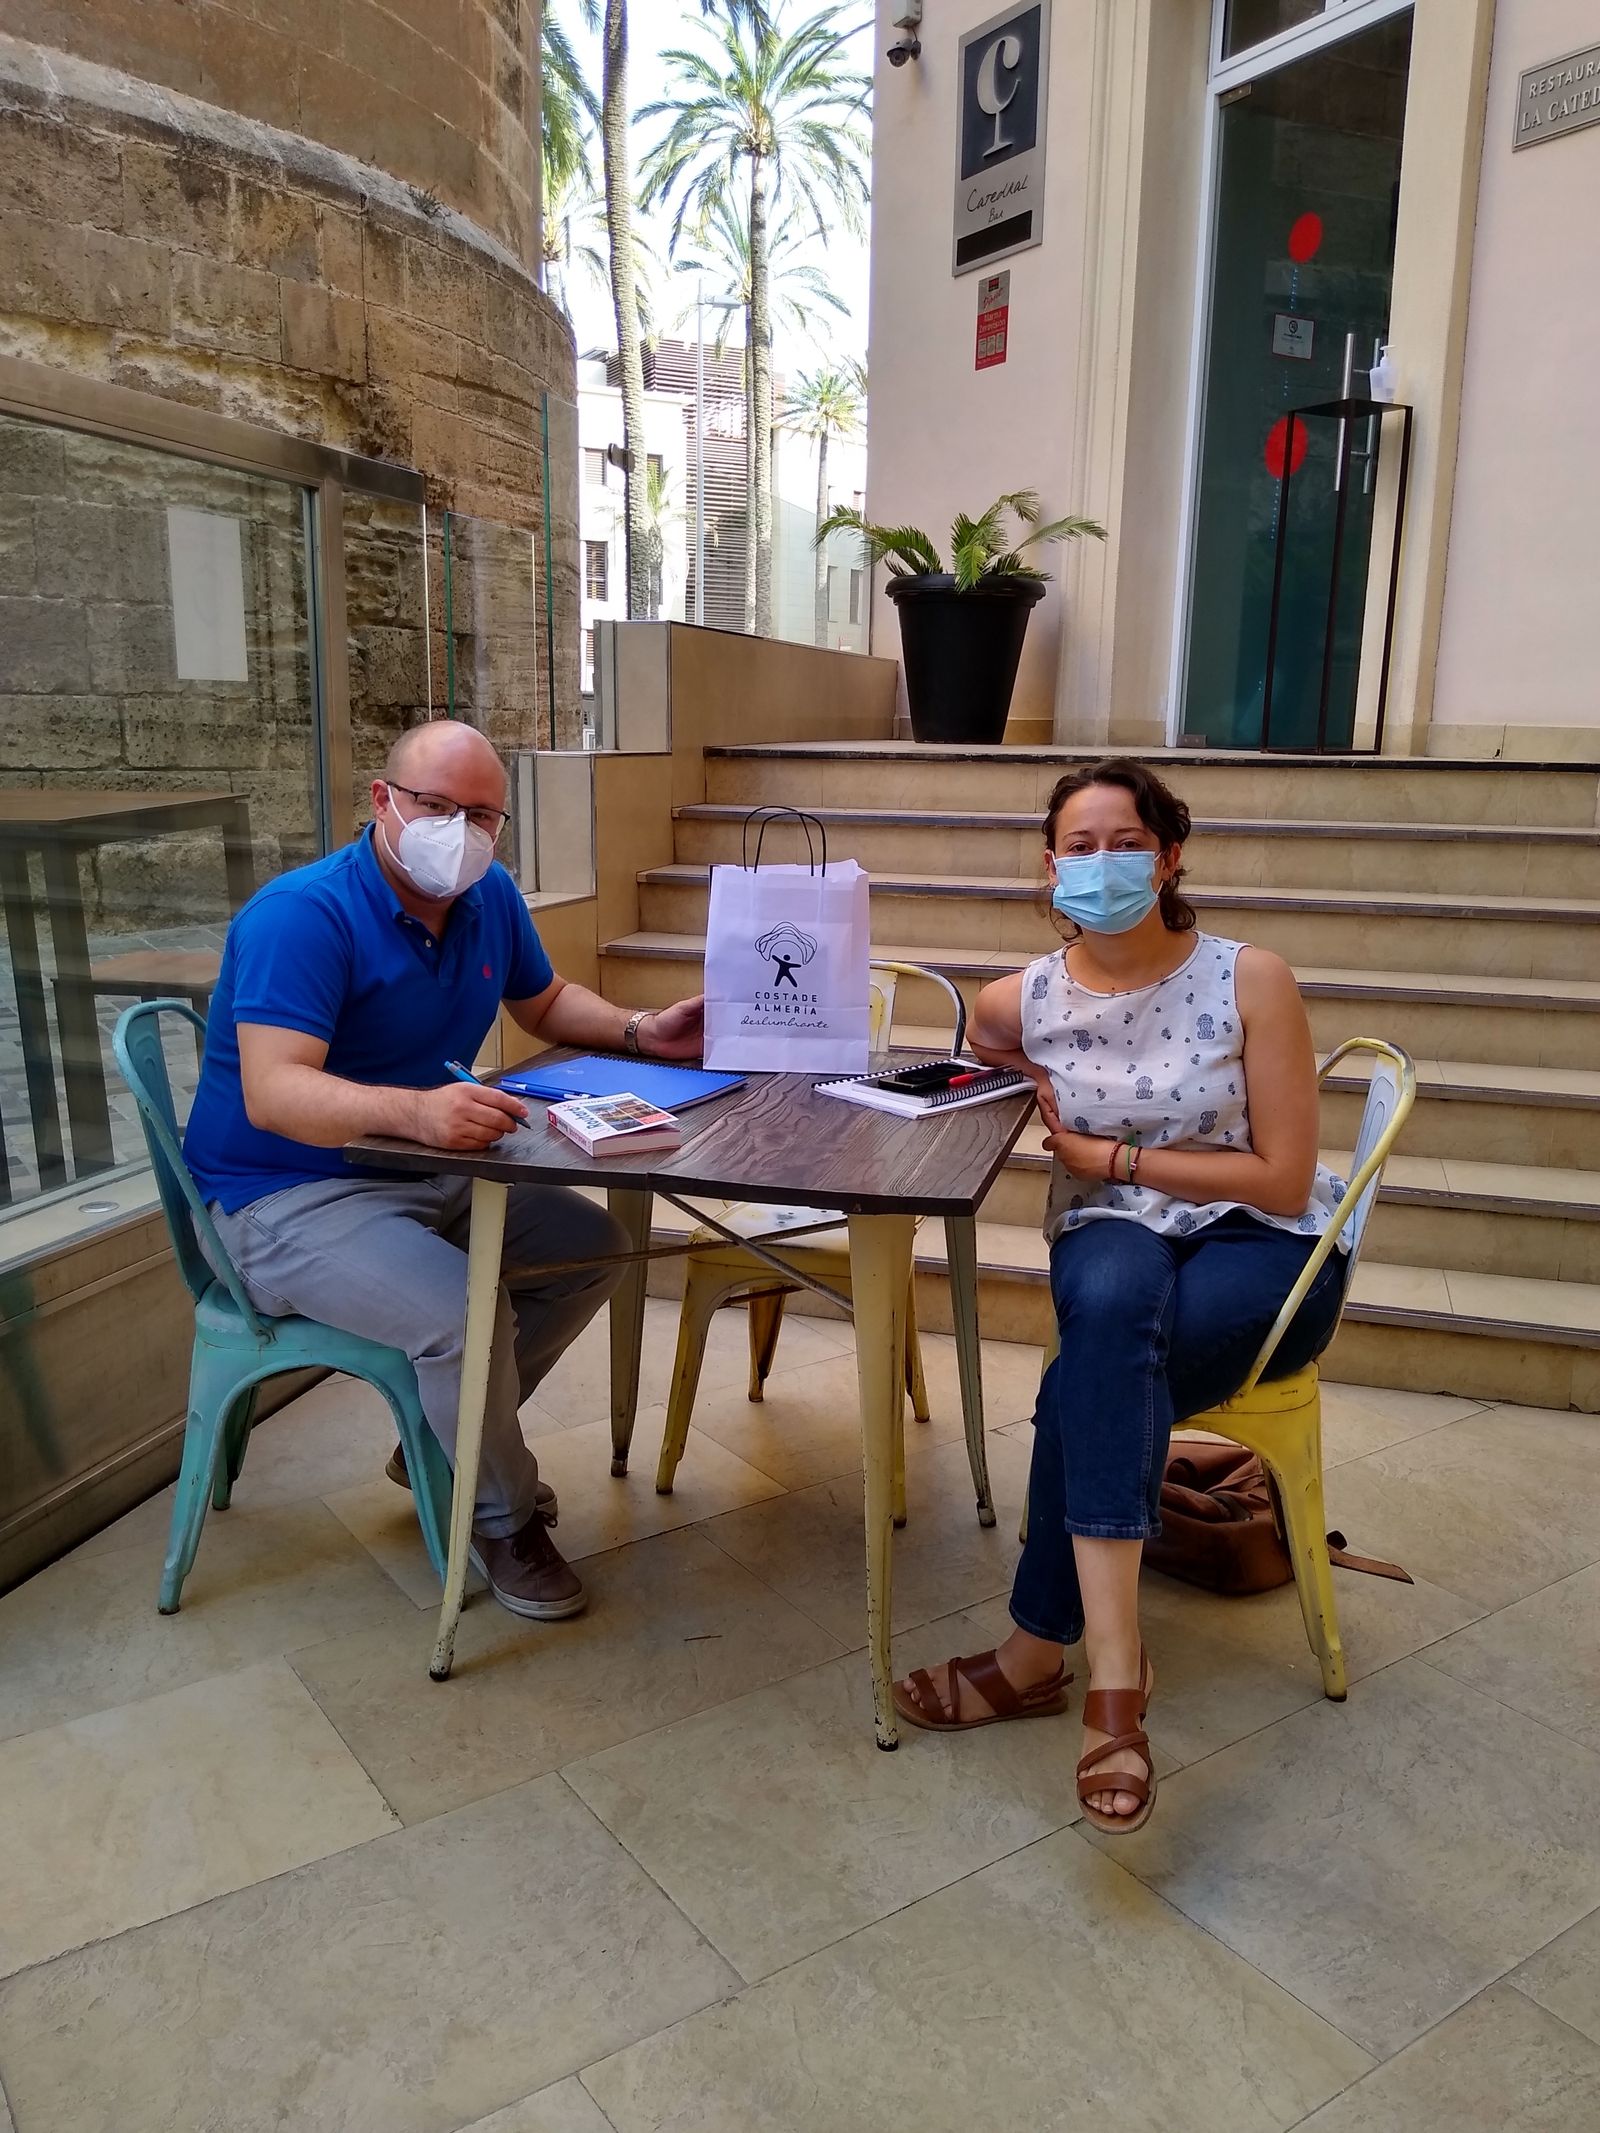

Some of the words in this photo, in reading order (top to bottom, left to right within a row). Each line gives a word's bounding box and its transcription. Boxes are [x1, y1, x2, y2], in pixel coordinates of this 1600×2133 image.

[1521, 107, 1542, 131] LA
[754, 1003, 817, 1015] ALMERÍA
[740, 1015, 830, 1029] deslumbrante
